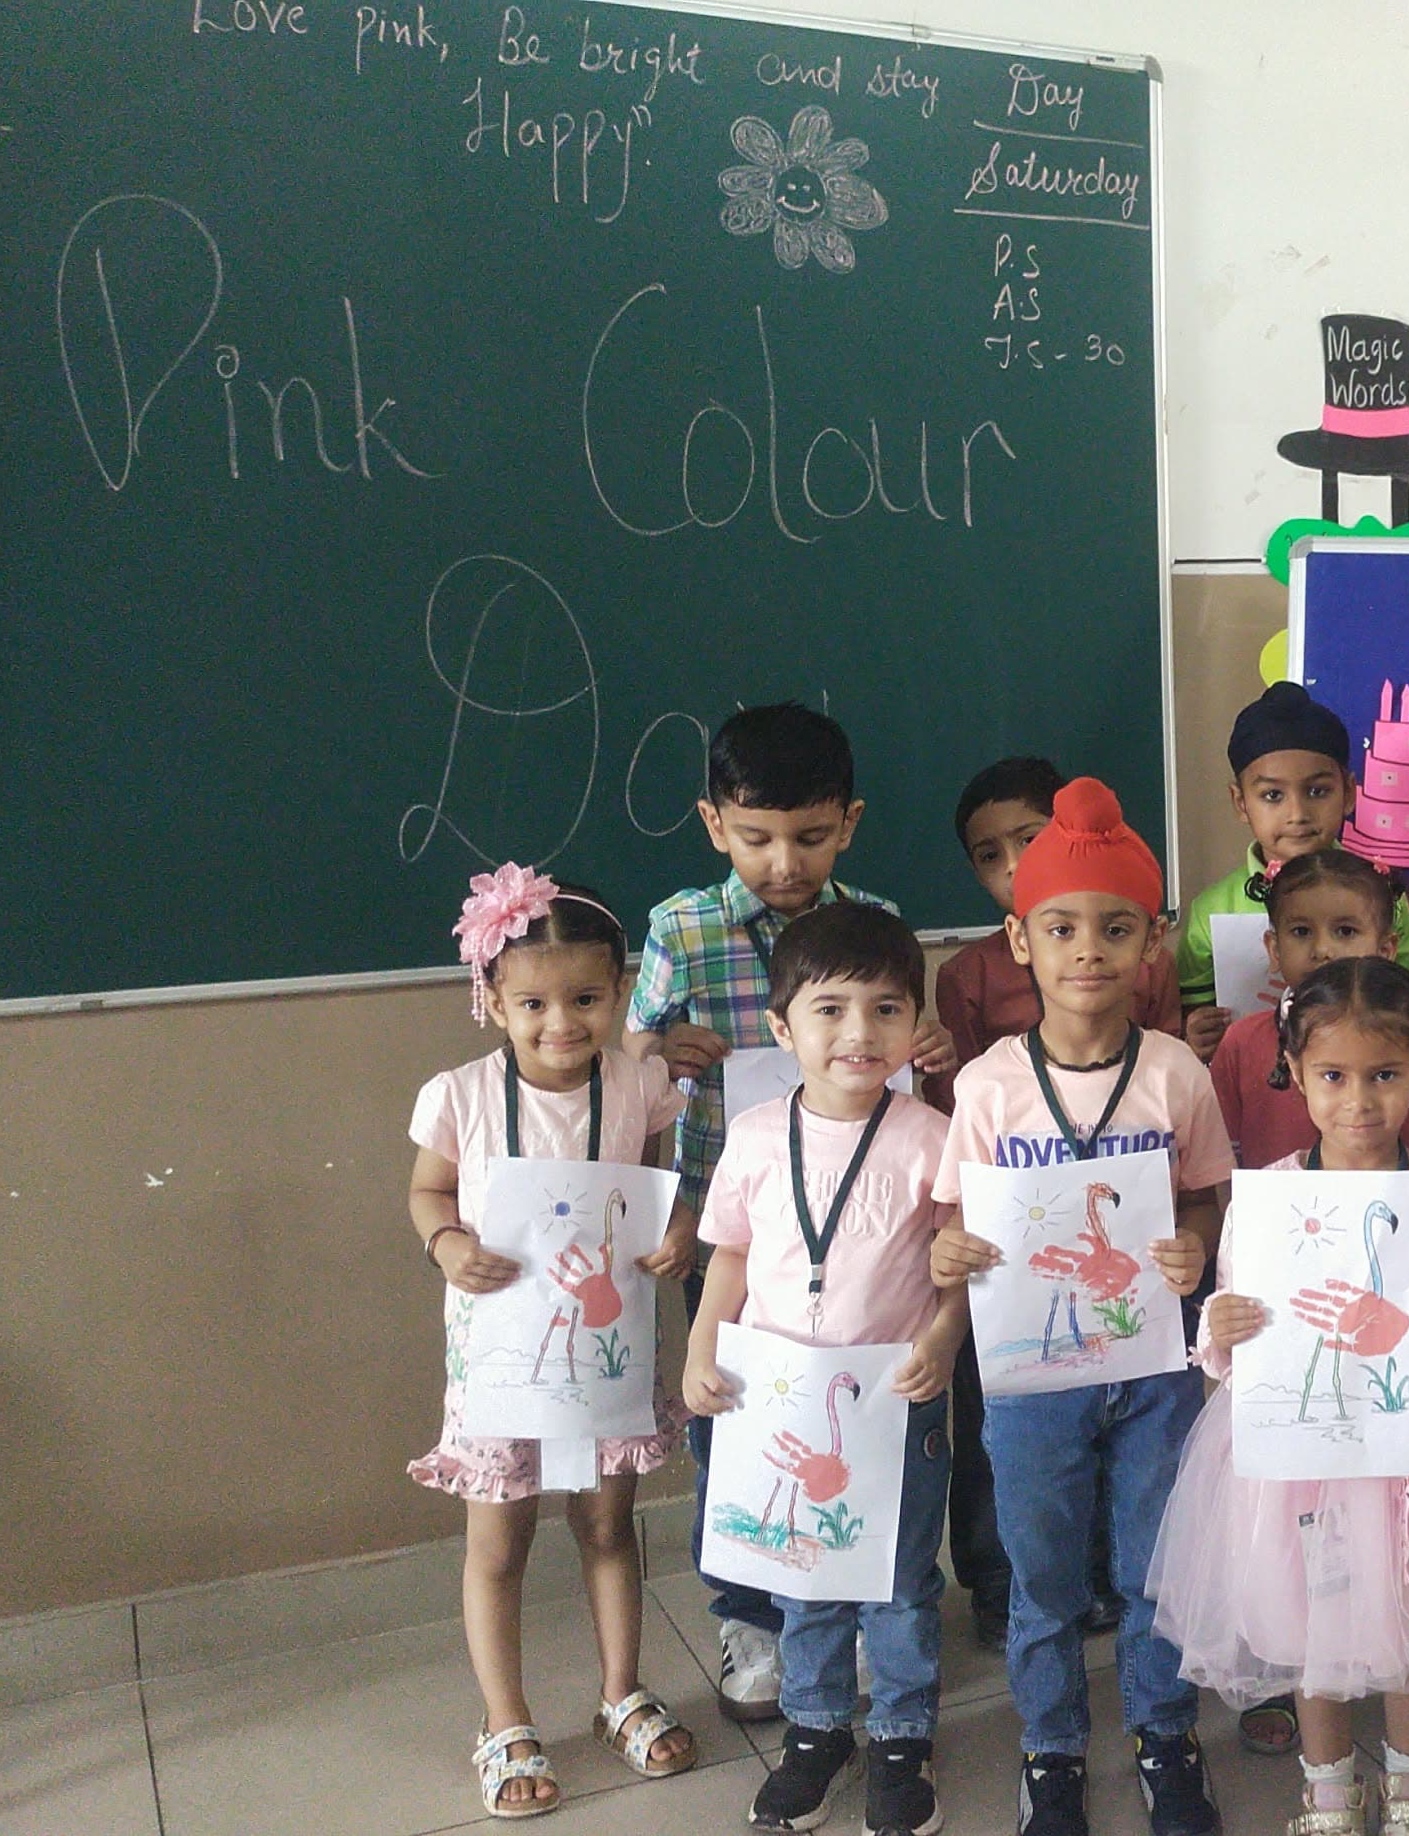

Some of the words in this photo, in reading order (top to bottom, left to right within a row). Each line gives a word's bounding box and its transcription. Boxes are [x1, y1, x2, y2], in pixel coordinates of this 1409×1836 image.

[498, 6, 549, 64] Be
[579, 17, 705, 101] bright
[865, 55, 939, 119] stay
[1008, 63, 1083, 131] Day
[965, 141, 1140, 219] Saturday
[57, 194, 447, 490] Pink
[1084, 333, 1126, 366] 30
[1327, 325, 1404, 375] Magic
[584, 283, 1016, 542] Colour
[1329, 368, 1407, 409] Words
